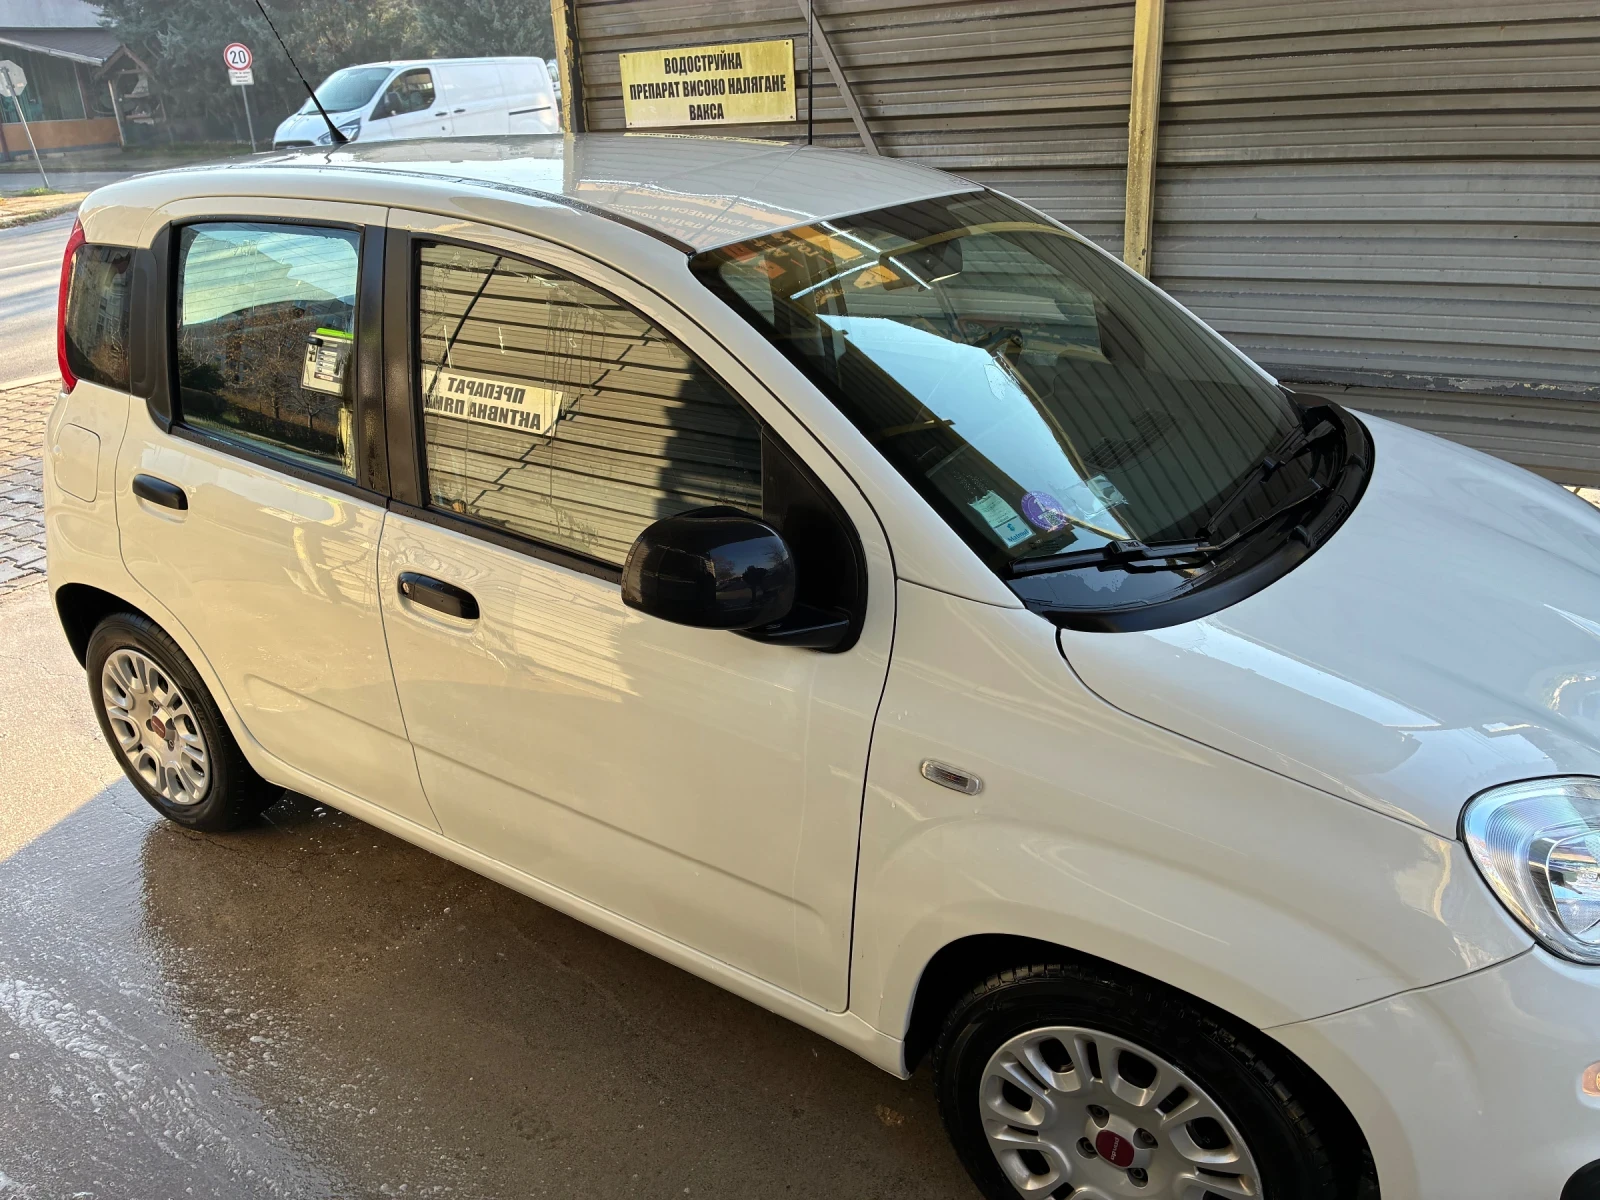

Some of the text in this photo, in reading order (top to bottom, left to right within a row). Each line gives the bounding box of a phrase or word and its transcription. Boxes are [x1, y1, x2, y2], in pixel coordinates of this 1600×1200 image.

[229, 50, 247, 64] 20
[663, 50, 743, 76] ВОДОСТРУЙКА
[629, 74, 787, 100] ПРЕПАРАТ ВИСОКО НАЛЯГАНЕ
[688, 103, 725, 121] ВАКСА
